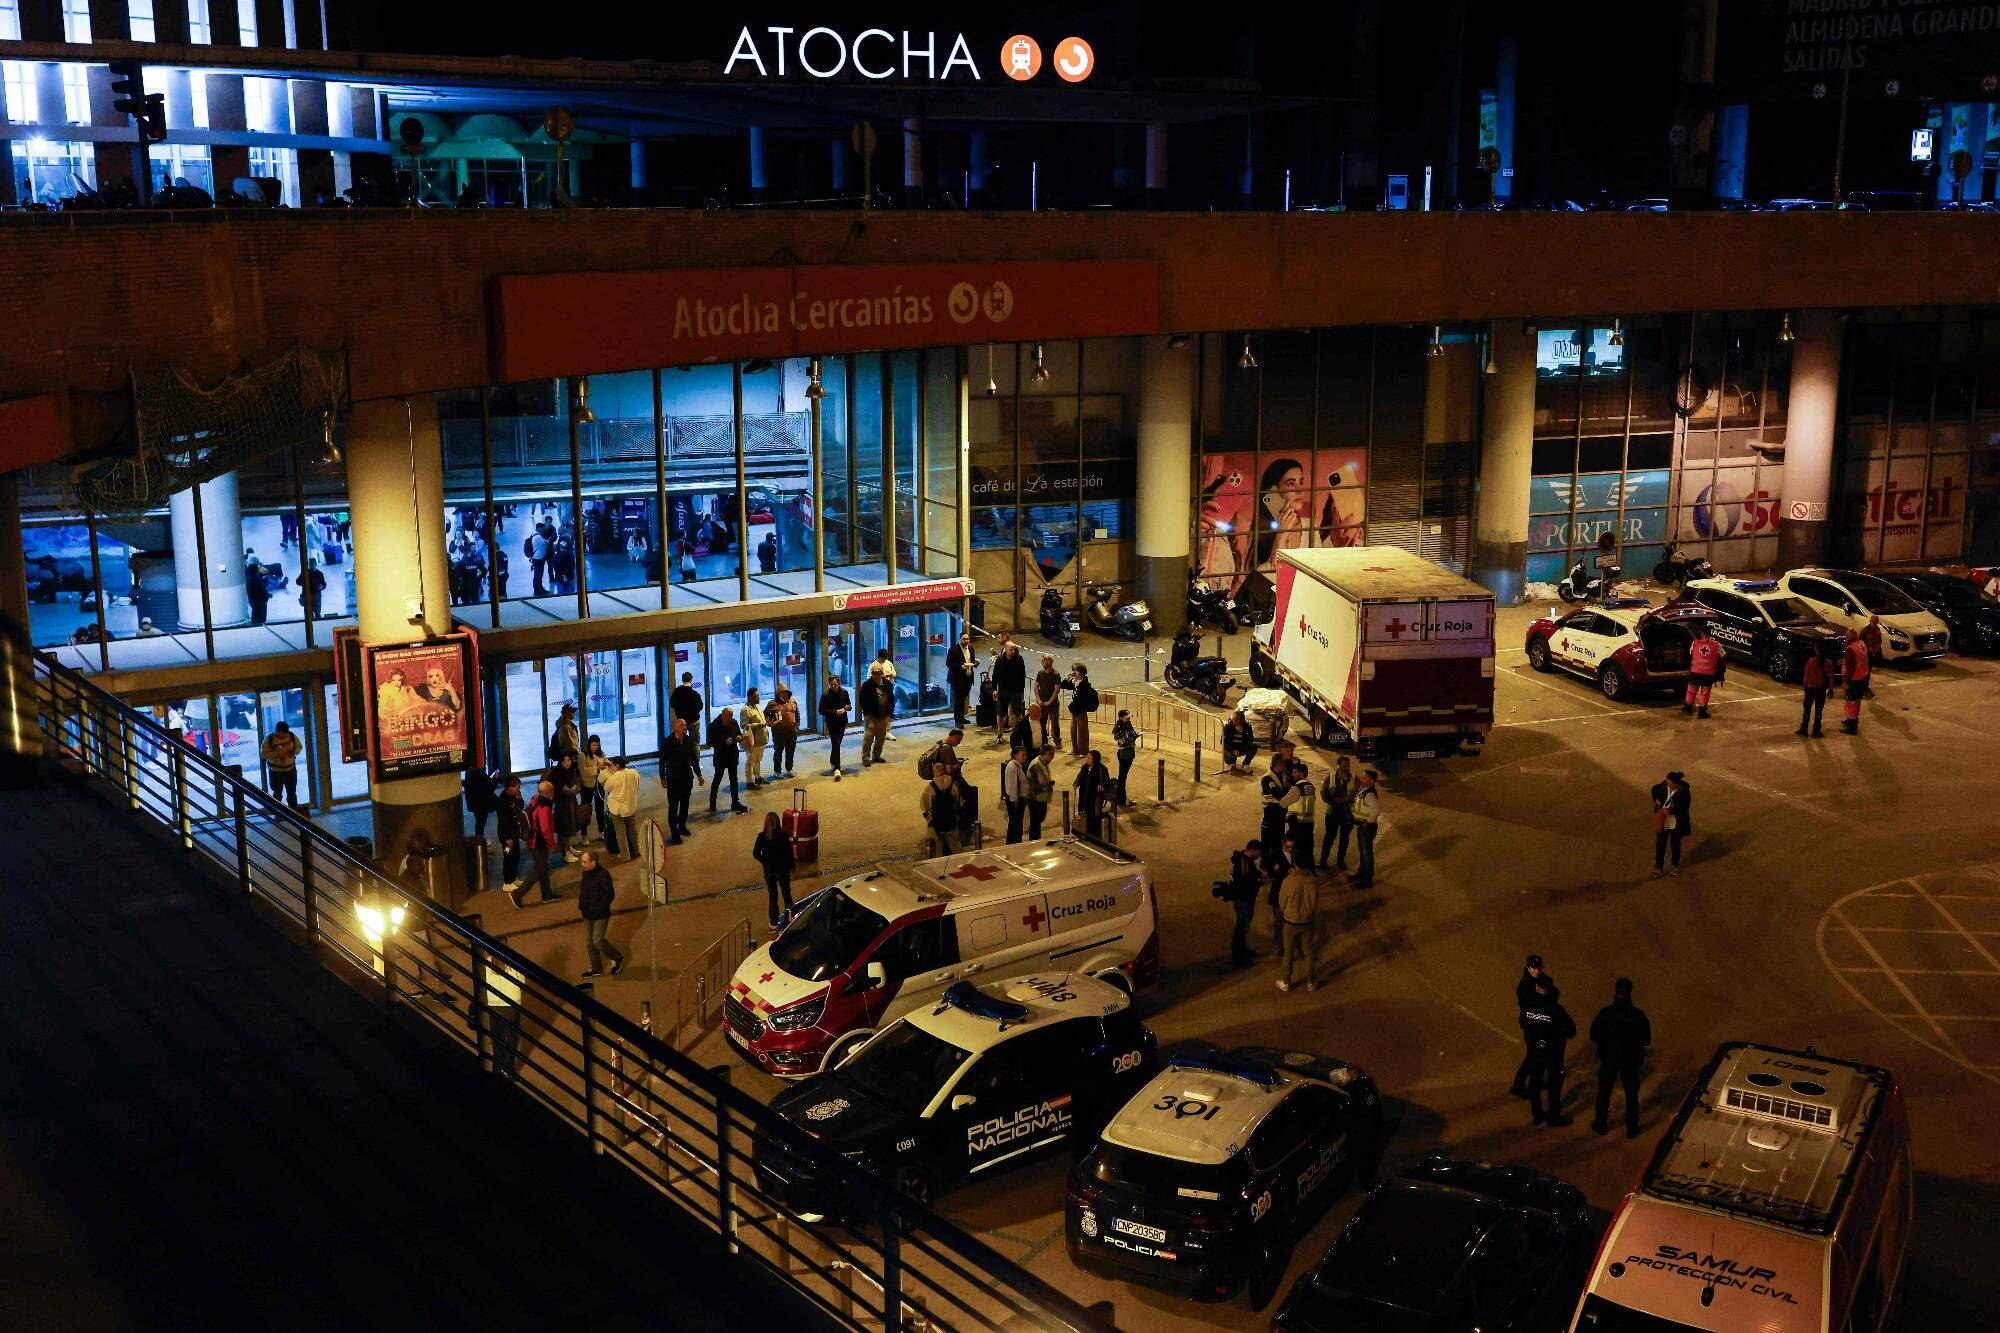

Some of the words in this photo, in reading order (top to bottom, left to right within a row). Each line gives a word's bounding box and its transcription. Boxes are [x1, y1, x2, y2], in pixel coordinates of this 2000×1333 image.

[723, 25, 981, 80] ATOCHA
[1783, 45, 1867, 73] SALIDAS
[673, 292, 779, 340] Atocha
[790, 284, 935, 332] Cercanías
[973, 479, 998, 493] café
[1024, 473, 1048, 493] La
[1054, 475, 1103, 489] estación
[675, 501, 688, 530] renfe
[1307, 624, 1318, 641] Cruz
[1411, 622, 1440, 632] Cruz
[1444, 620, 1473, 633] Roja
[1570, 643, 1584, 655] Cruz
[1051, 902, 1083, 920] Cruz
[1086, 895, 1116, 912] Roja
[967, 1100, 1052, 1140] POLICIA
[901, 1137, 916, 1151] 091
[968, 1110, 1073, 1156] NACIONAL
[1103, 1234, 1163, 1258] POLICIA
[1655, 1245, 1777, 1282] SAMUR
[1751, 1284, 1799, 1306] CIVIL
